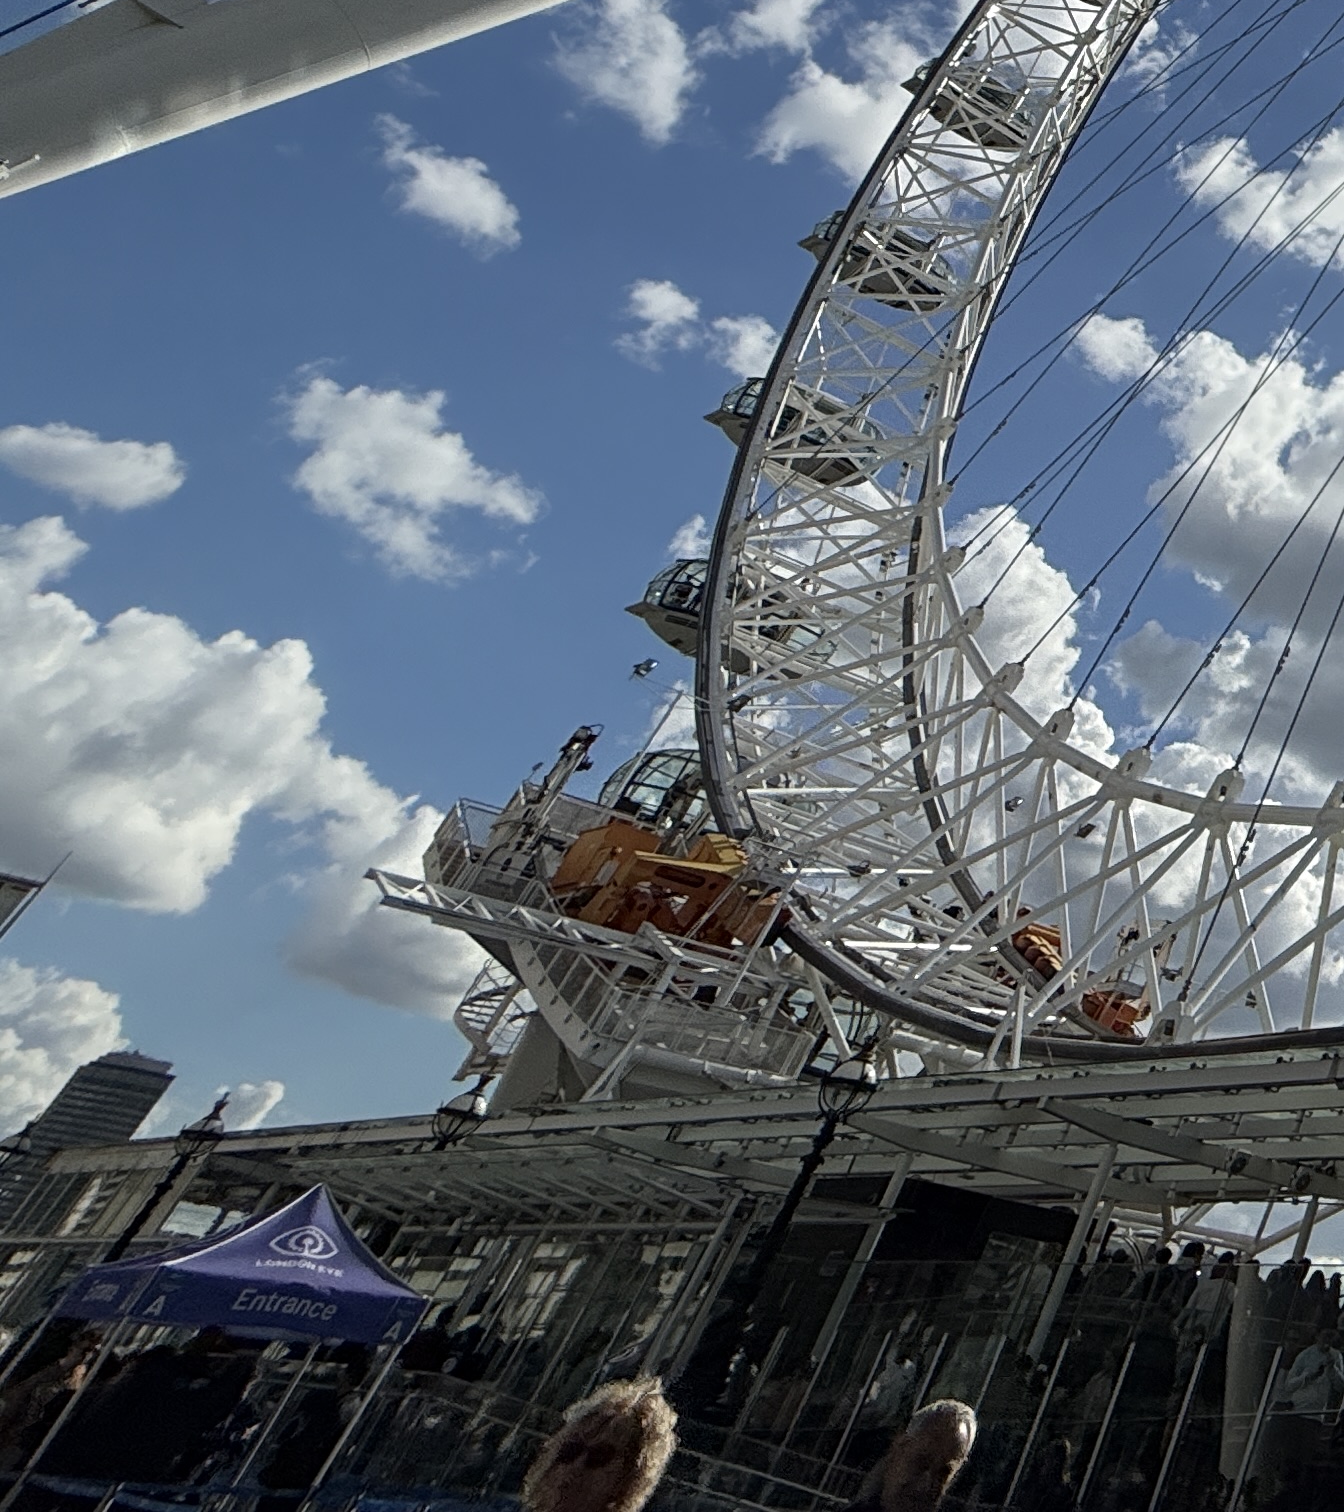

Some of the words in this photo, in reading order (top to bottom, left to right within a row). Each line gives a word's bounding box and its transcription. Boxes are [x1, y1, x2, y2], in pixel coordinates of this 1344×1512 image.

[255, 1258, 317, 1271] LONDON
[317, 1264, 344, 1278] EYE
[142, 1294, 167, 1316] A
[232, 1288, 338, 1321] Entrance
